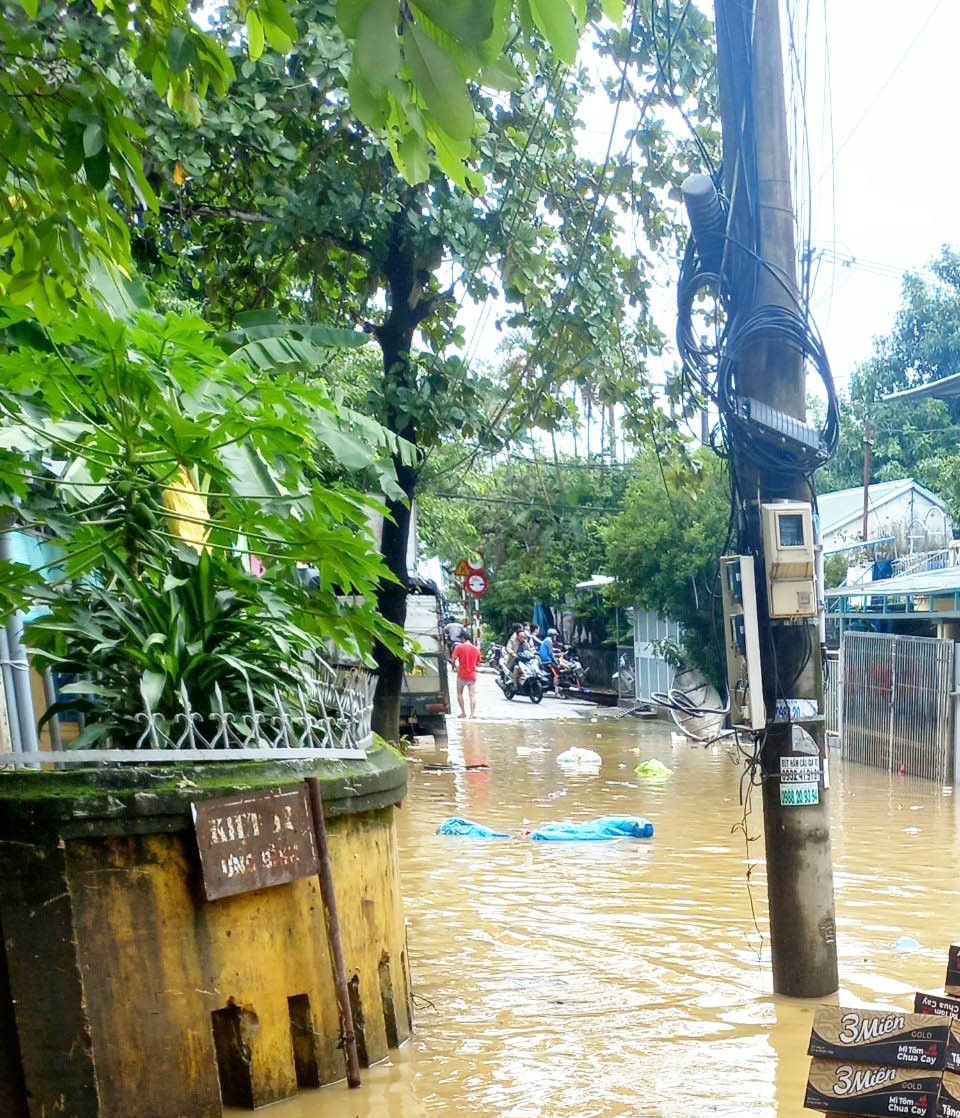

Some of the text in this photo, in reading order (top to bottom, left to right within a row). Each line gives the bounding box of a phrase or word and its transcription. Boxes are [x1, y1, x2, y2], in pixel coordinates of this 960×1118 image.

[922, 997, 959, 1012] Chua Cay
[911, 1030, 933, 1040] GOLD
[898, 1045, 924, 1055] Mì Tôm
[897, 1053, 937, 1064] Chua Cay
[902, 1082, 922, 1090] GOLD
[889, 1096, 914, 1106] Mì Tôm
[888, 1104, 927, 1116] Chua Cay
